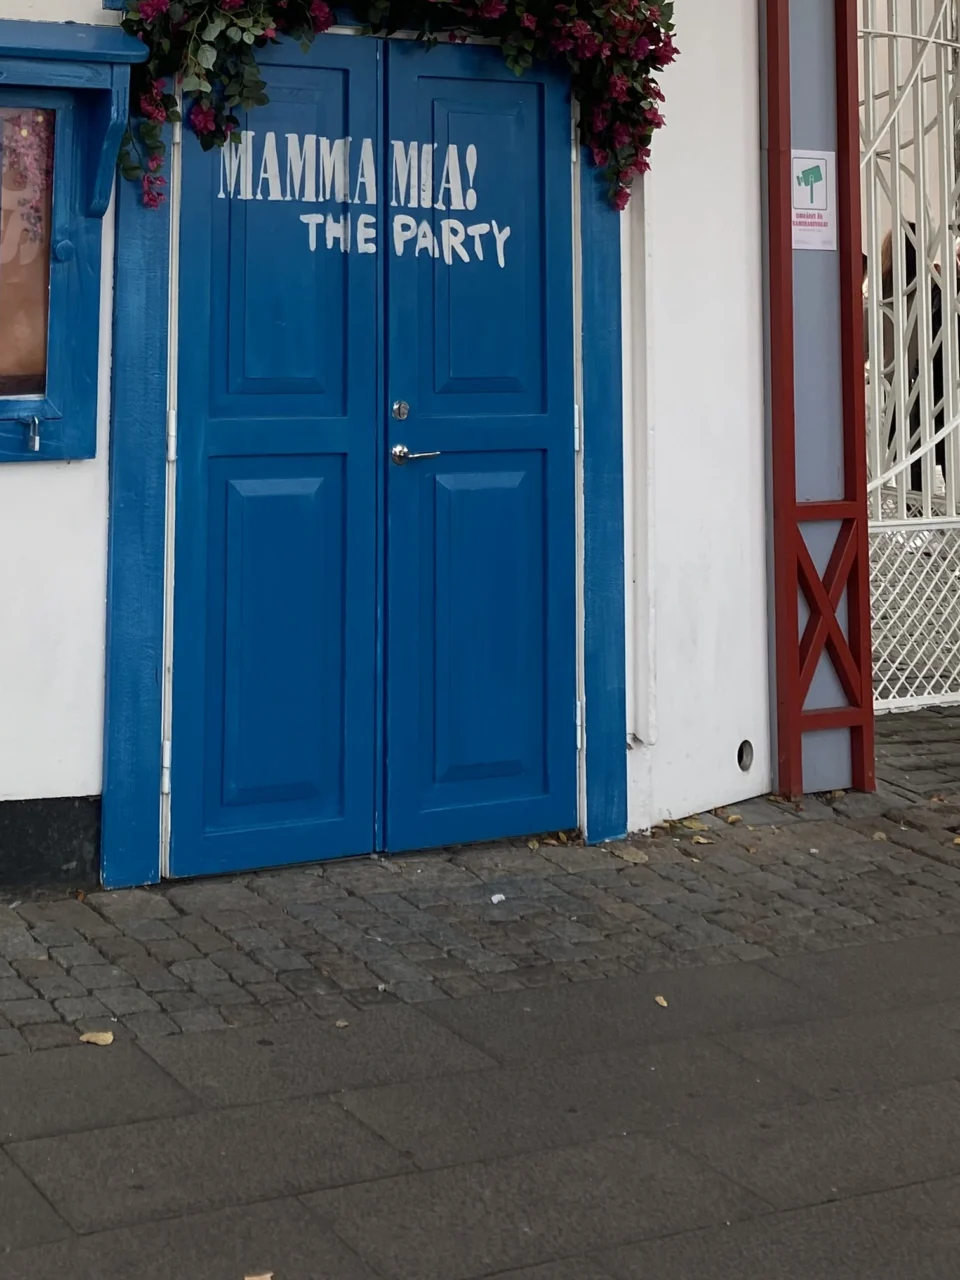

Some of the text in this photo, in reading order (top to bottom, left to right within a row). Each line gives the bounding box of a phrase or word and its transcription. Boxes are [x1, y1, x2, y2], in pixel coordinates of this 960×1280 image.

[217, 130, 478, 211] MAMMA MIA!
[299, 213, 511, 269] THE PARTY
